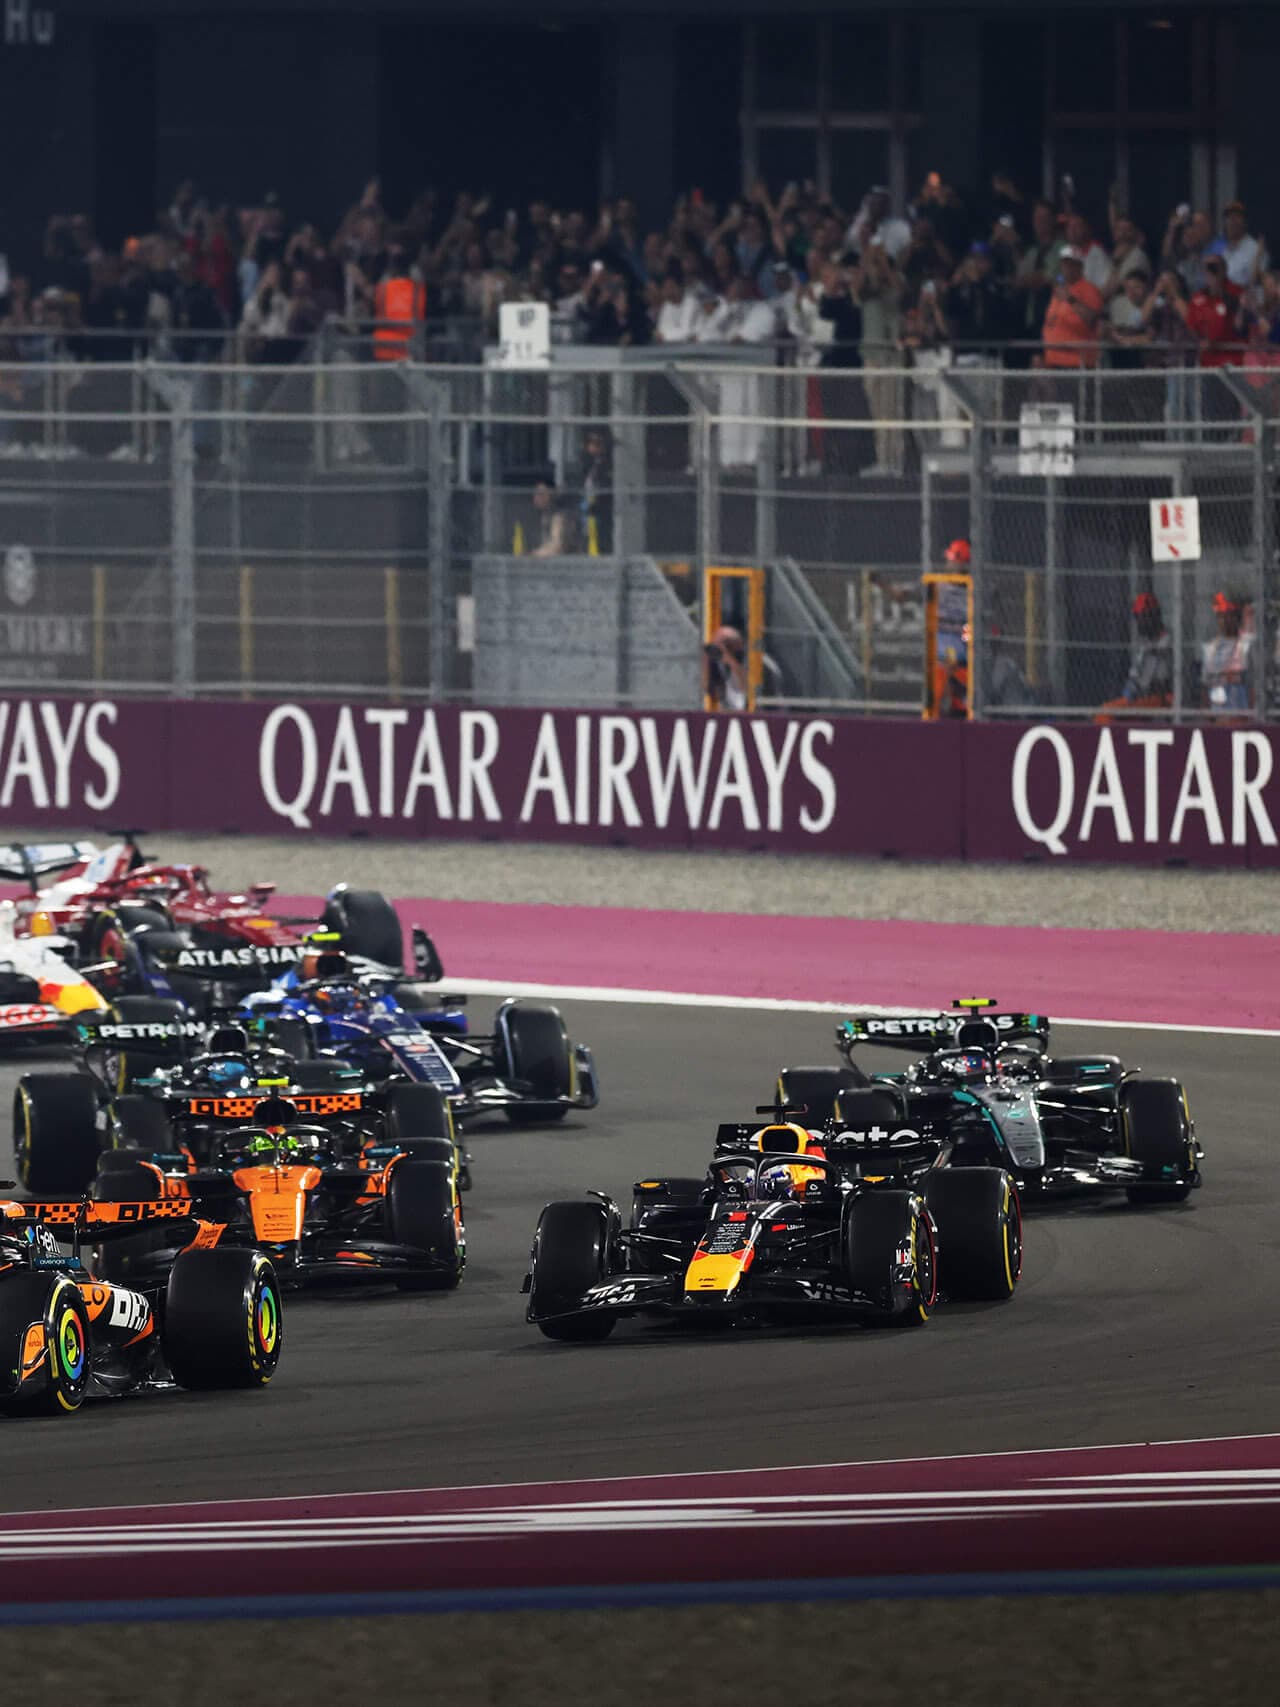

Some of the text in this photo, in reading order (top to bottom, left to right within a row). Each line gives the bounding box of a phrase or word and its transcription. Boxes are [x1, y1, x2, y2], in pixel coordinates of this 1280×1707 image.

[258, 702, 837, 834] QATAR AIRWAYS
[1011, 724, 1279, 855] QATAR
[177, 946, 316, 968] ATLASSIAN
[99, 1020, 208, 1039] PETRON
[867, 1015, 1015, 1035] PETROS
[796, 1280, 874, 1304] VISA
